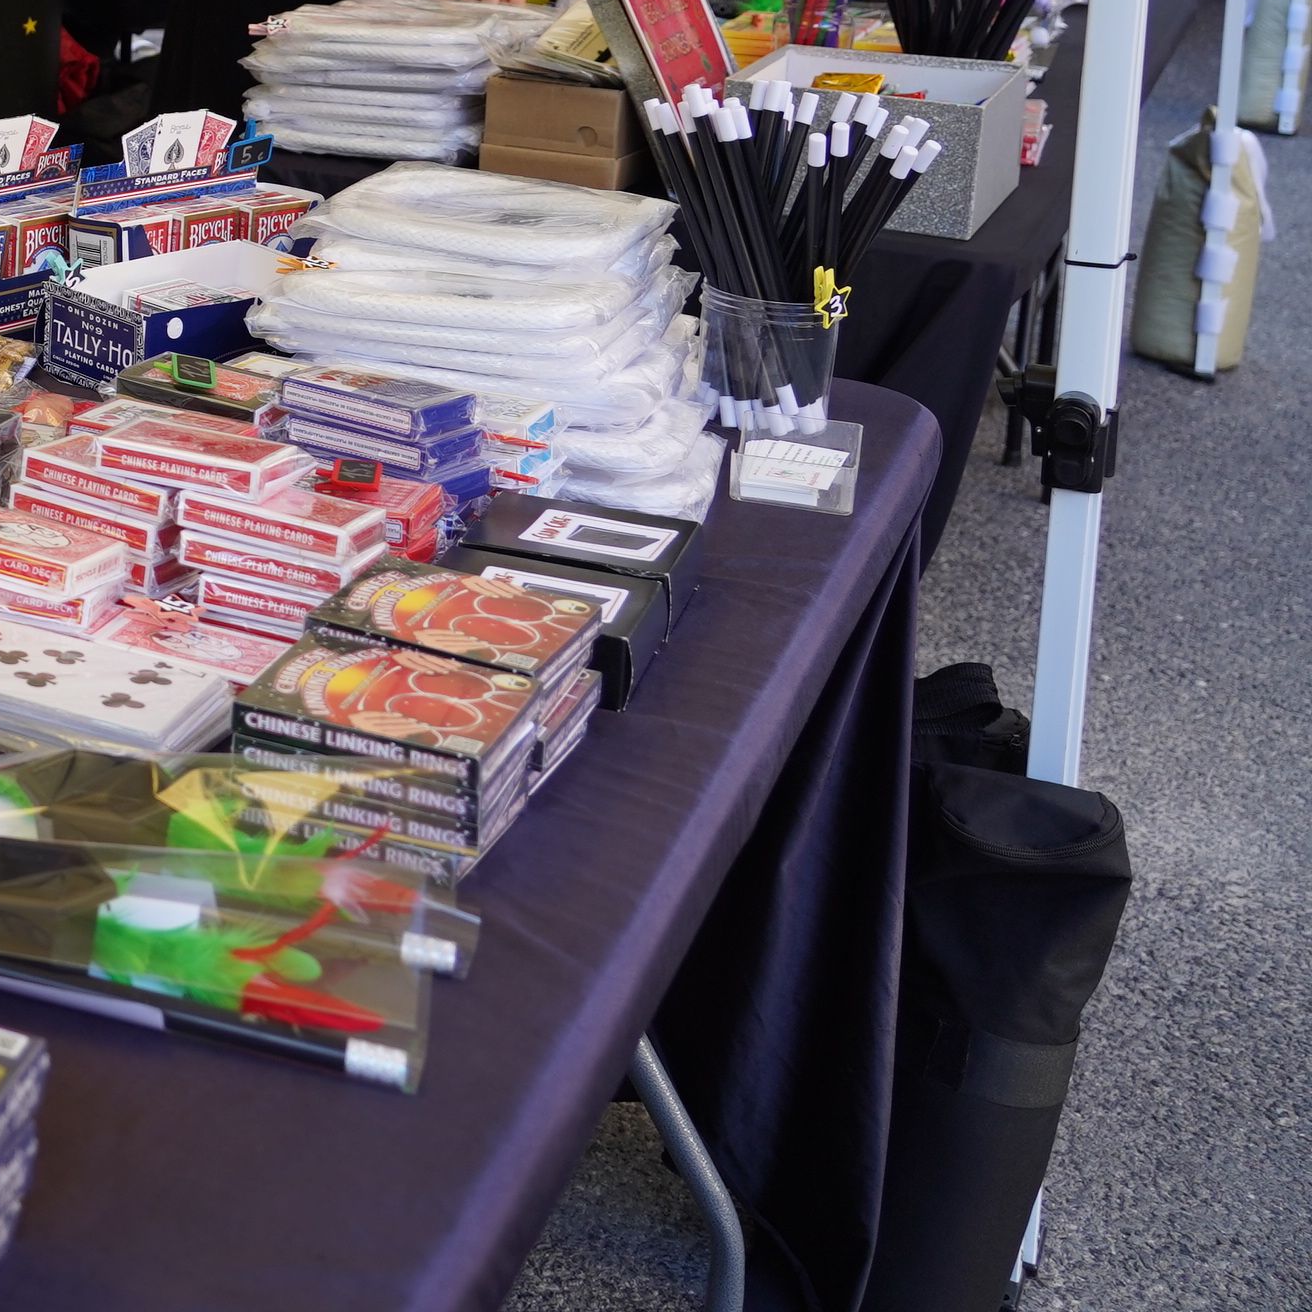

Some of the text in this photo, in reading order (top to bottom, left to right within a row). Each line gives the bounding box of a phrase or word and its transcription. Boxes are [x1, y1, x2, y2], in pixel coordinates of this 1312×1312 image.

[5, 171, 31, 183] FACES
[36, 150, 70, 176] BICYCLE
[134, 167, 208, 186] STANDARD FACES
[189, 216, 234, 249] BICYCLE
[67, 305, 120, 331] ONE DOZEN
[830, 295, 843, 318] 3
[52, 318, 135, 369] TALLY-HO
[64, 349, 120, 376] PLAYING CARDS
[121, 454, 229, 484] CHINESE PLAYING CARDS
[43, 467, 141, 504] CHINESE PLAYING CARDS
[31, 503, 127, 539] CHINESE PLAYING CARDS
[204, 509, 314, 546] CHINESE PLAYING CARDS
[4, 558, 30, 574] CARD
[205, 550, 318, 585] CHINESE PLAYING CARDS
[16, 594, 74, 614] CARD DECK
[225, 592, 264, 610] CHINESE
[244, 711, 469, 778] CHINESE LINKING RINGS
[243, 746, 467, 815] CHINESE LINKING RINGS
[241, 784, 466, 847] CHINESE LINKING RINGS
[385, 846, 450, 878] RINGS
